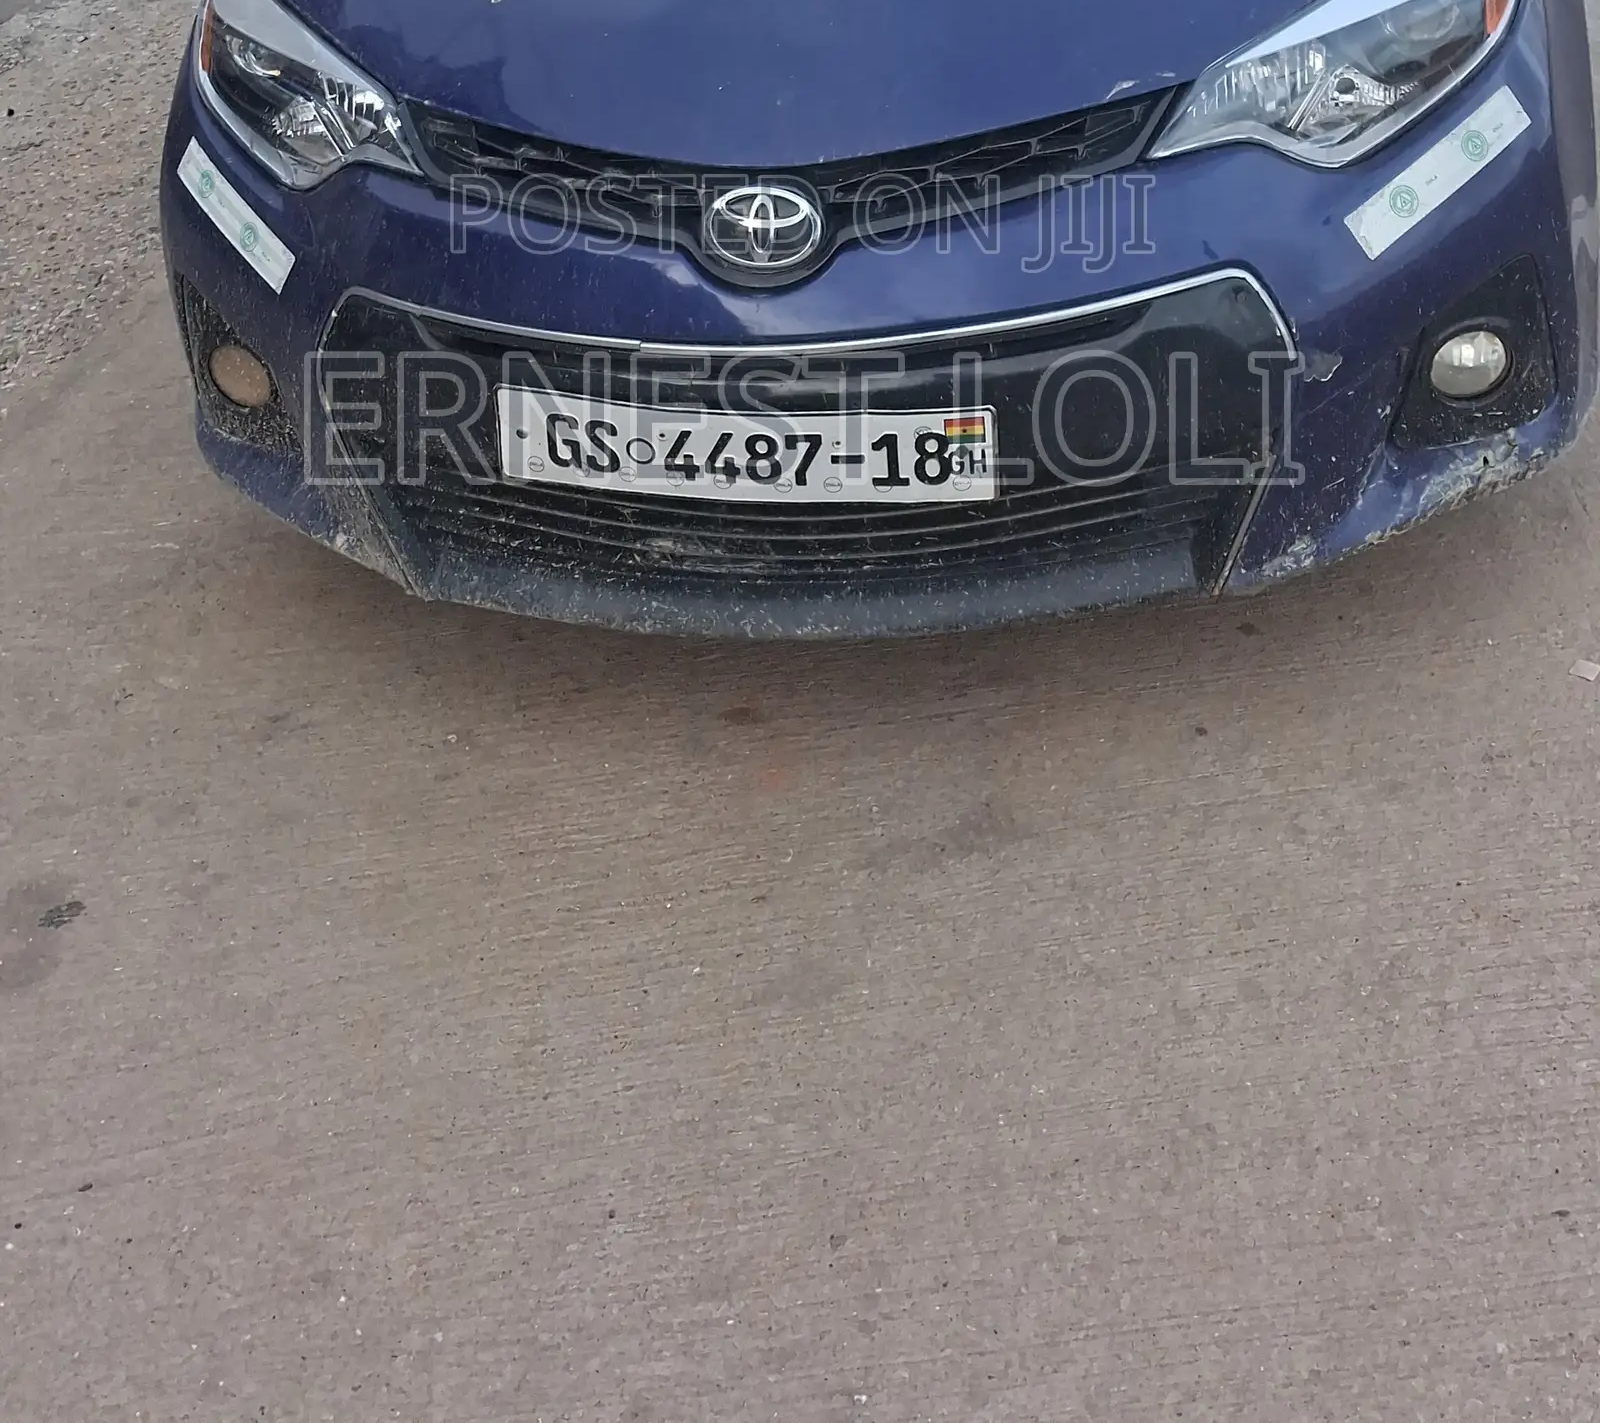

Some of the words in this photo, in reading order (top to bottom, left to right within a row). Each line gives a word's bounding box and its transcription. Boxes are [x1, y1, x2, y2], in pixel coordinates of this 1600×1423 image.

[545, 412, 621, 473] GS
[663, 429, 951, 487] 4487-18
[948, 448, 988, 475] GH
